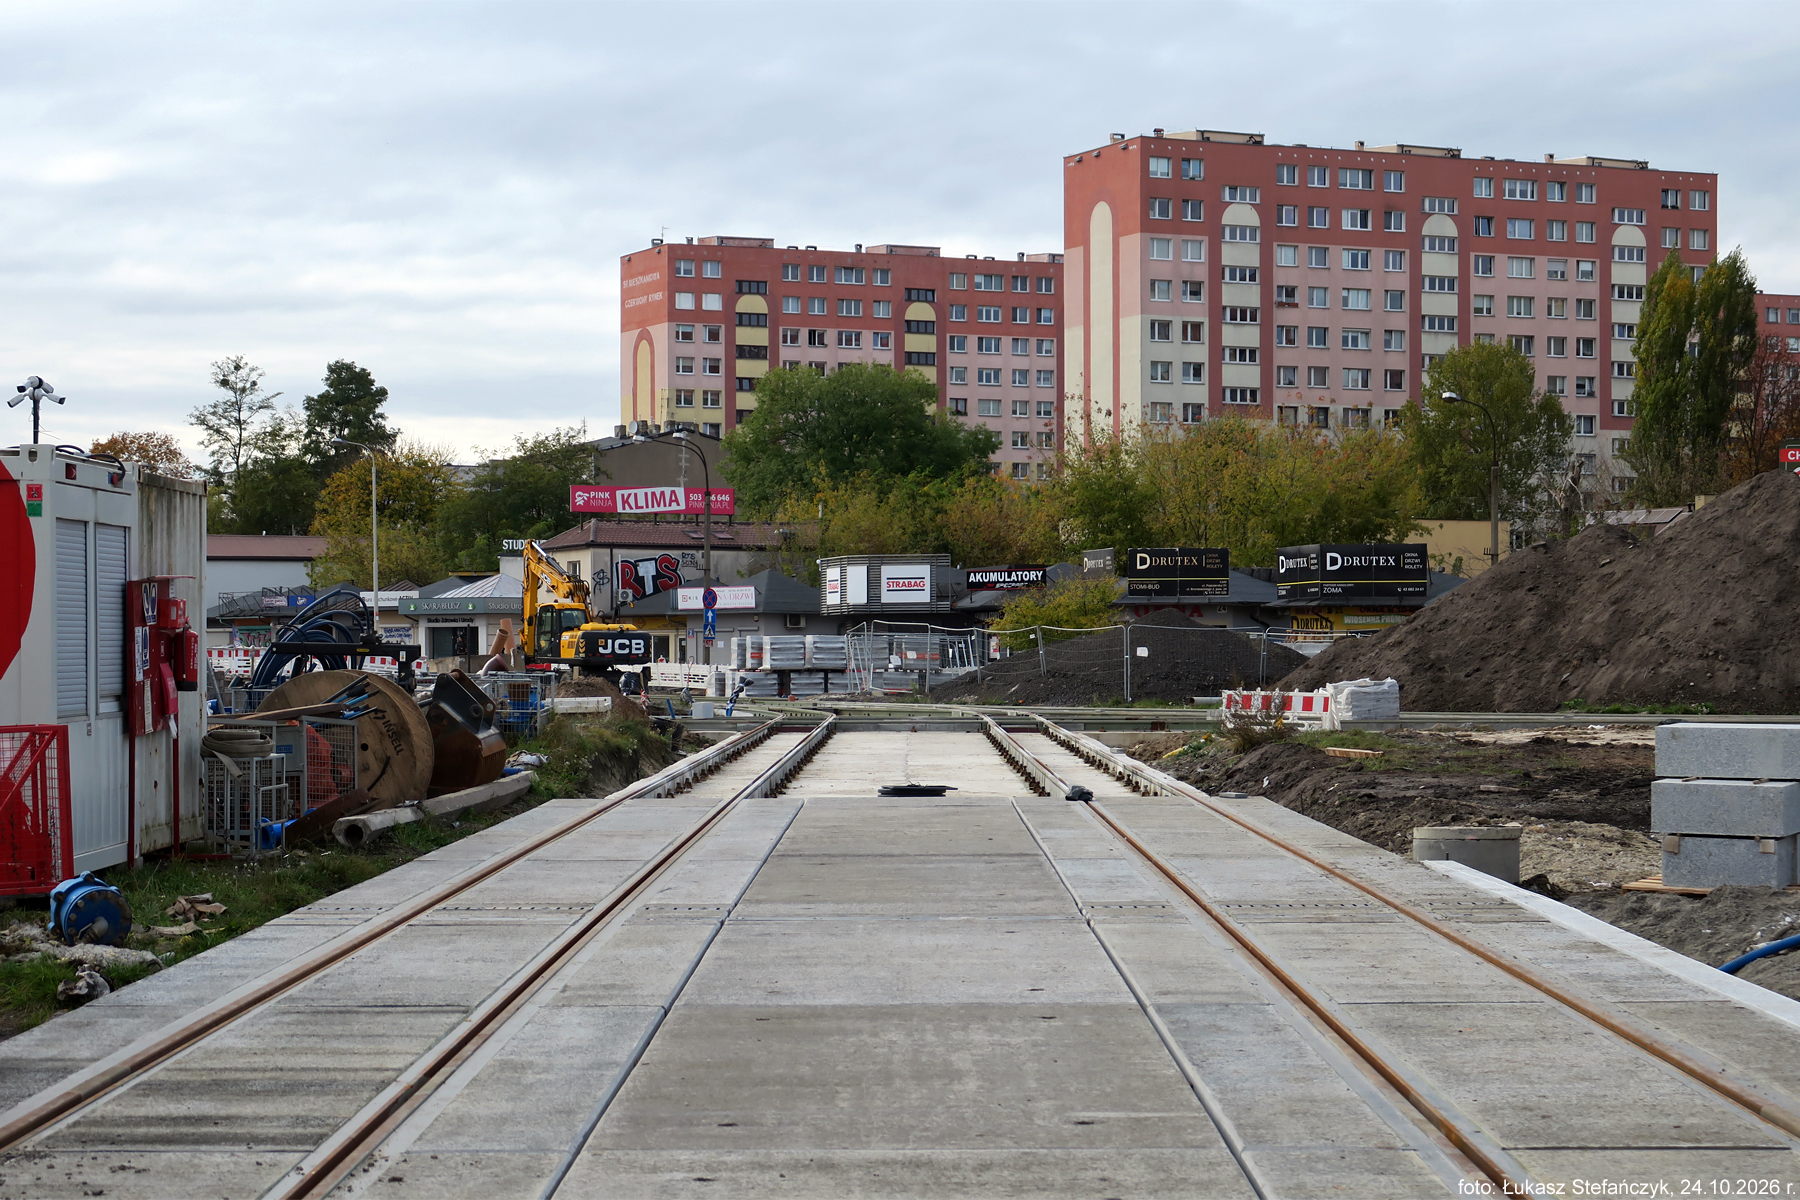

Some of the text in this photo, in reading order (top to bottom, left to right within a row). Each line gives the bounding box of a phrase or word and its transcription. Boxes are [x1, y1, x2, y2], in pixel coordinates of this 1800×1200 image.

[590, 491, 610, 499] PINK
[621, 489, 680, 511] KLIMA
[689, 493, 702, 501] 503
[590, 499, 612, 507] NINJA
[689, 501, 730, 509] PINKNNJA.PL
[502, 539, 526, 550] STUD
[1152, 556, 1198, 566] DRUTEX
[1286, 557, 1308, 569] DRUTEX
[1344, 556, 1396, 566] DRUTEX
[617, 554, 681, 599] RTS
[969, 571, 1043, 583] AKUMULATORY
[886, 580, 926, 588] STRABAG
[421, 602, 461, 610] SKARABEUSZ
[488, 602, 523, 610] Studio Uro
[1300, 617, 1329, 630] DRUTEX
[1344, 615, 1380, 624] WIOSENNA
[598, 639, 645, 654] JCB
